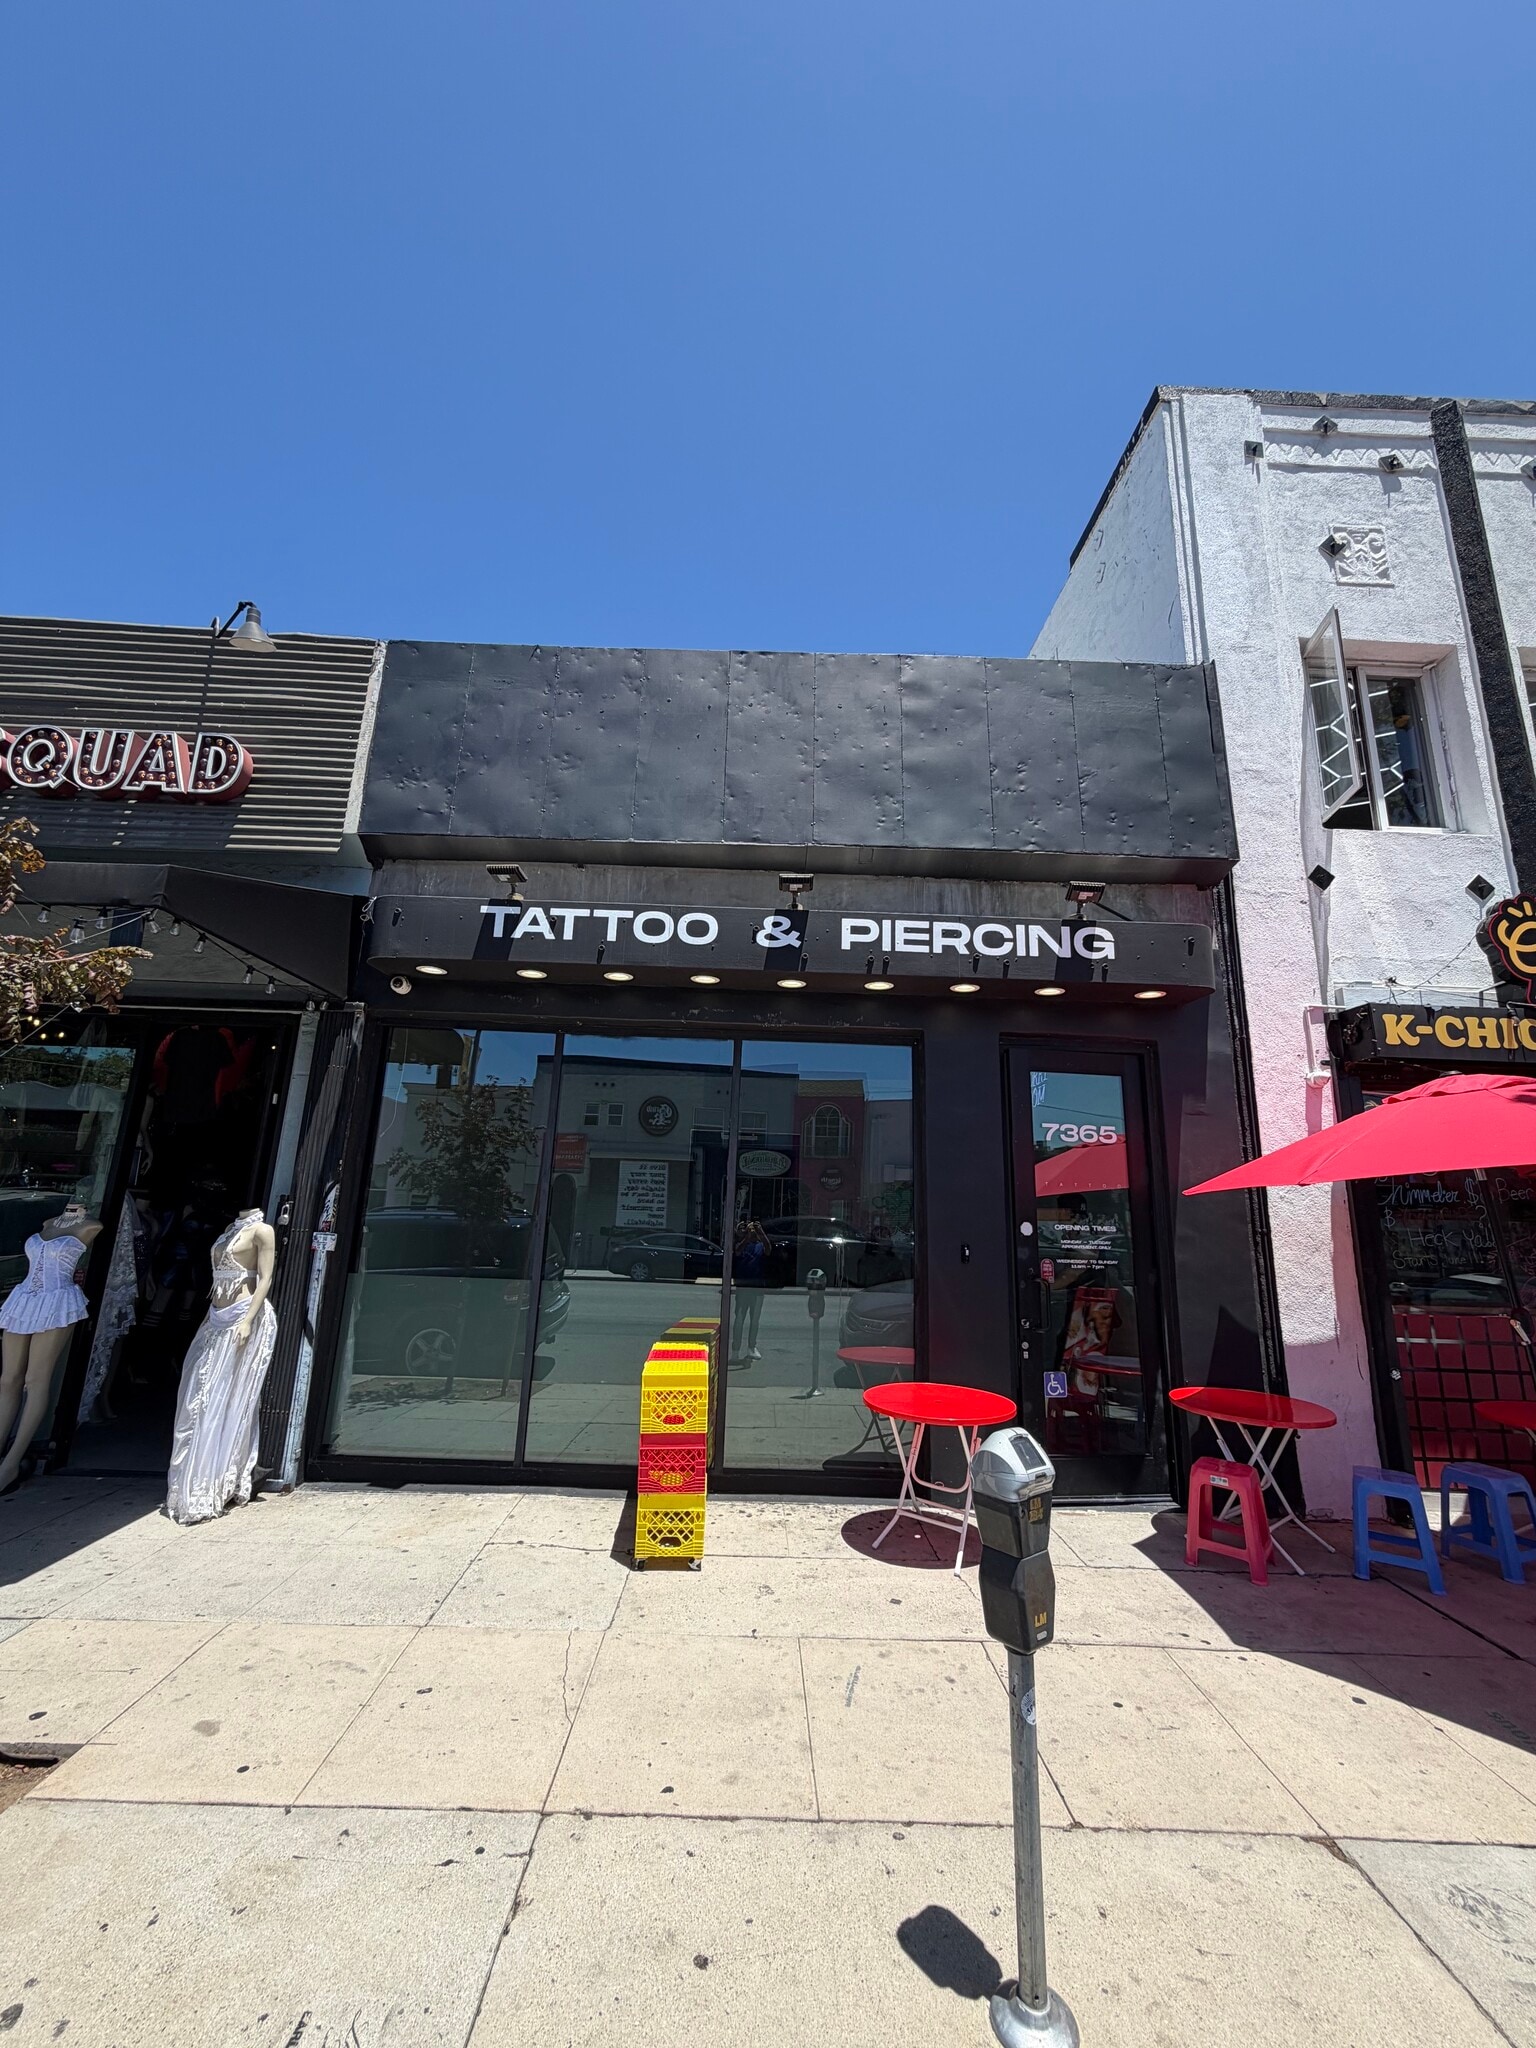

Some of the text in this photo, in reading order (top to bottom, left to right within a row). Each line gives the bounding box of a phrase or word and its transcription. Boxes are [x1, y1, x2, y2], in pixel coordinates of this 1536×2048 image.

[0, 724, 250, 797] QUAD
[480, 905, 1116, 960] TATTOO & PIERCING
[1041, 1122, 1118, 1145] 7365
[1054, 1224, 1090, 1232] OPENING
